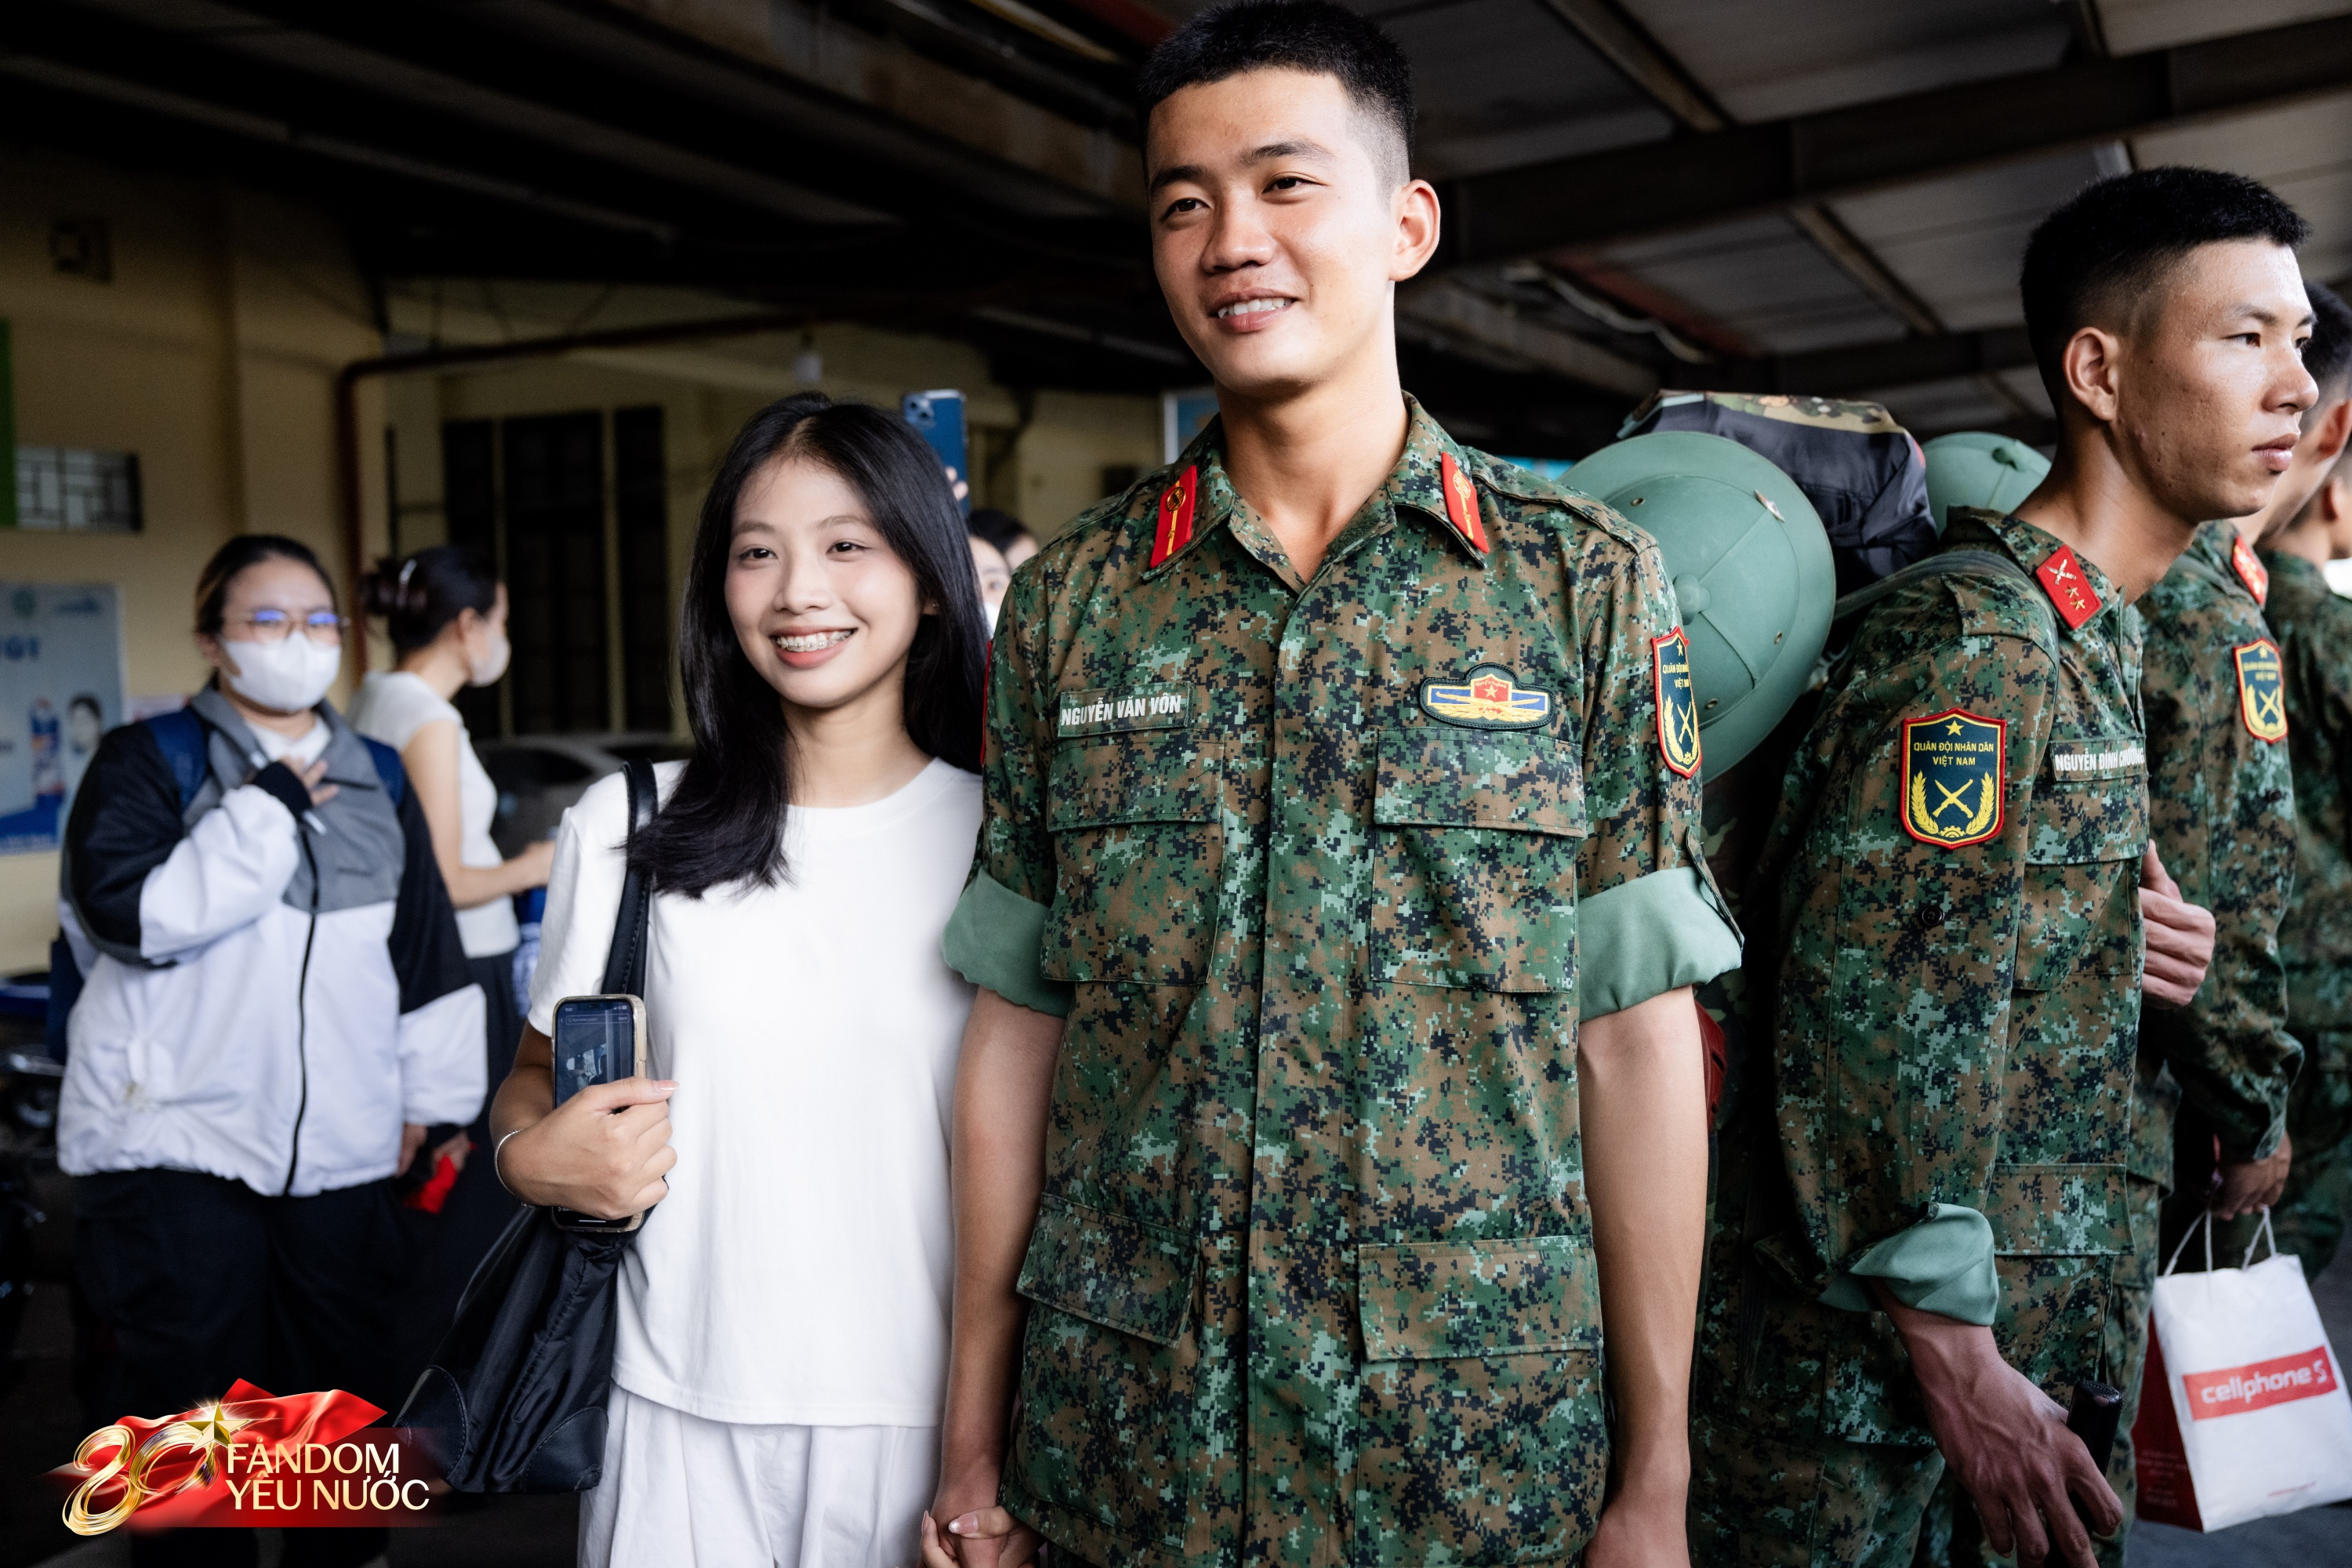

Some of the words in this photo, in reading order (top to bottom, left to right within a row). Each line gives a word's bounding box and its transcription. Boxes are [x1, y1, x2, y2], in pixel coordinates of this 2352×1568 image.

[1663, 662, 1676, 673] QUÂN
[1061, 697, 1114, 726] NGUYỄN
[1116, 695, 1146, 719] VĂN
[1150, 691, 1181, 715] VÔN
[1914, 741, 1937, 752] QUÂN
[1939, 741, 1953, 753] ĐỘI
[1955, 742, 1976, 753] NHÂN
[1978, 742, 1994, 753] DÂN
[1933, 755, 1953, 768] VIỆT
[1956, 757, 1976, 766] NAM
[2054, 747, 2096, 771] NGUYỄN
